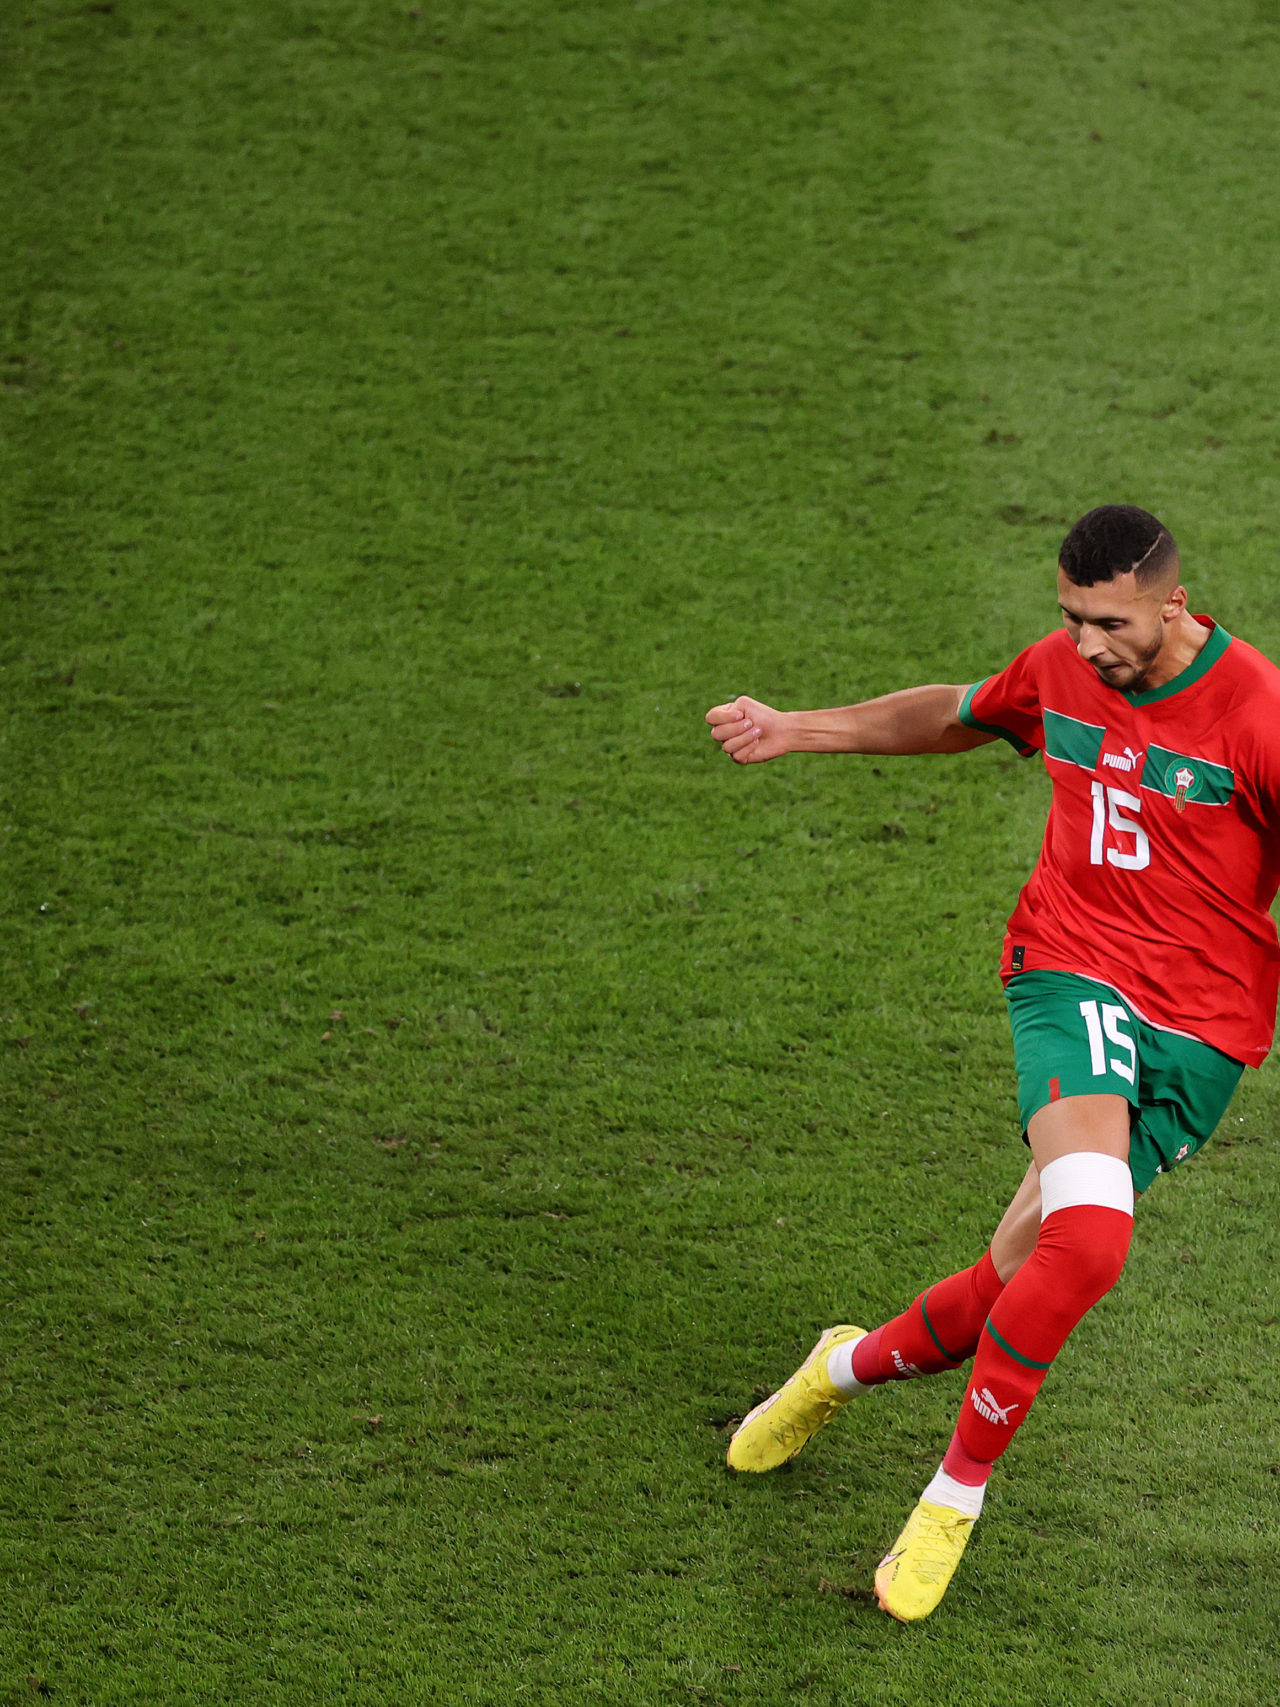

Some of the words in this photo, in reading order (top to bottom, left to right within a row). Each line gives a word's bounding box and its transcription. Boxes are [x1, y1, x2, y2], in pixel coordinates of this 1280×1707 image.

[1102, 752, 1132, 772] PUMA
[1090, 780, 1151, 871] 15
[1079, 999, 1136, 1087] 15
[971, 1386, 1000, 1425] PUMA
